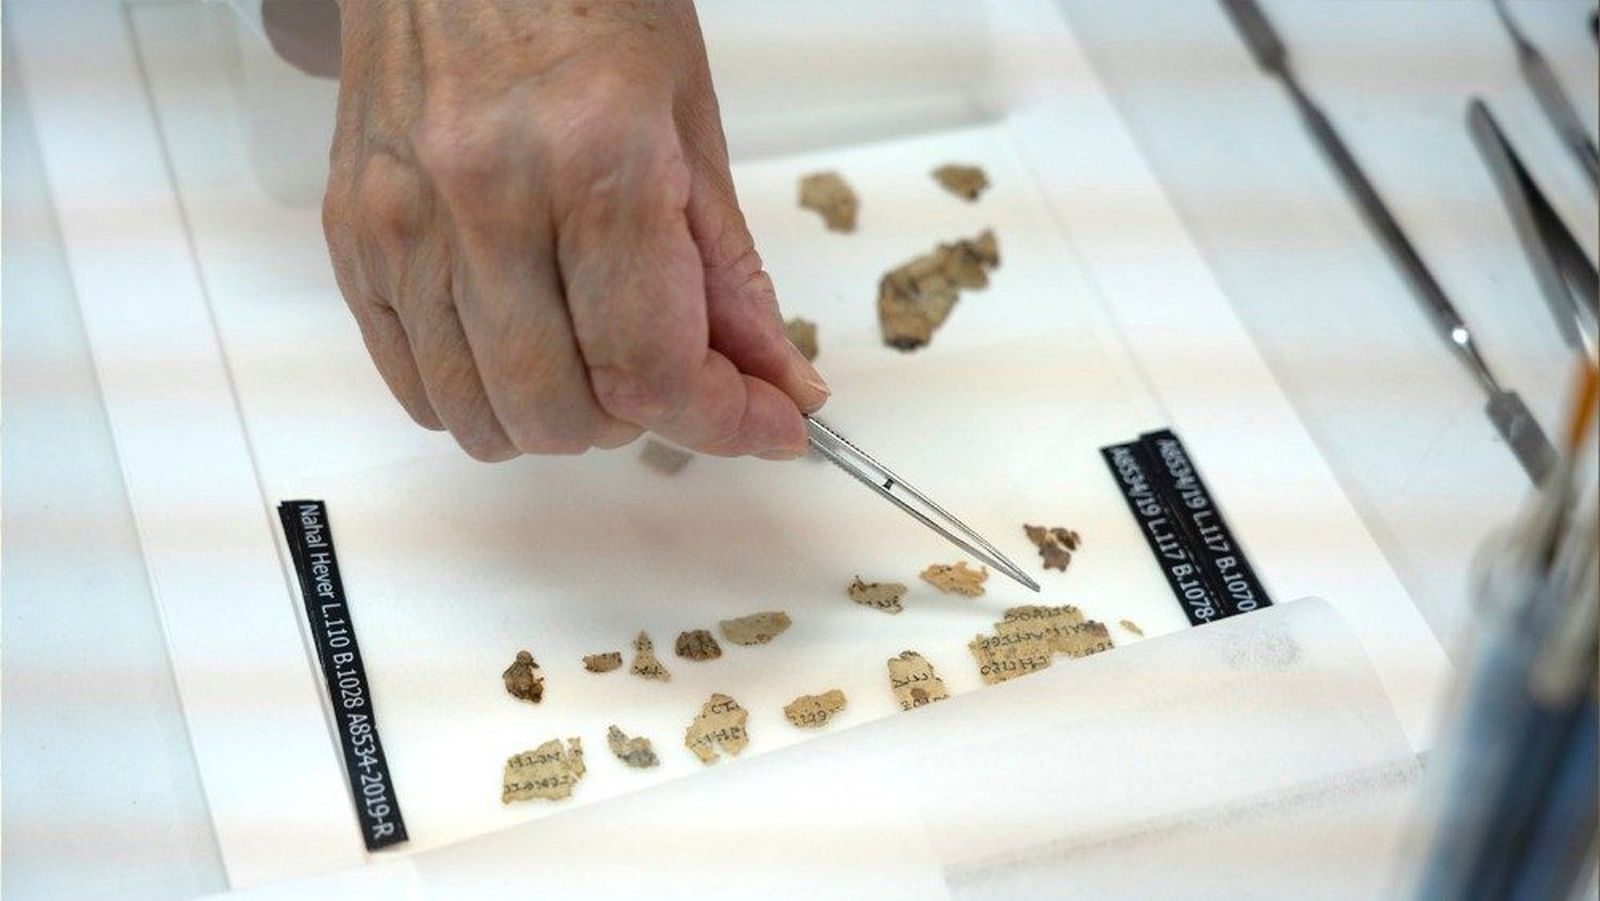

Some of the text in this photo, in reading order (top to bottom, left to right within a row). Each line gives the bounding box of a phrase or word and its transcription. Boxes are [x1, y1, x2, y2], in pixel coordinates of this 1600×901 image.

[1147, 518, 1186, 560] L.117
[1193, 510, 1230, 552] L.117
[300, 505, 394, 839] Nahal Hever L.110 B.1028 A8534-2019-R
